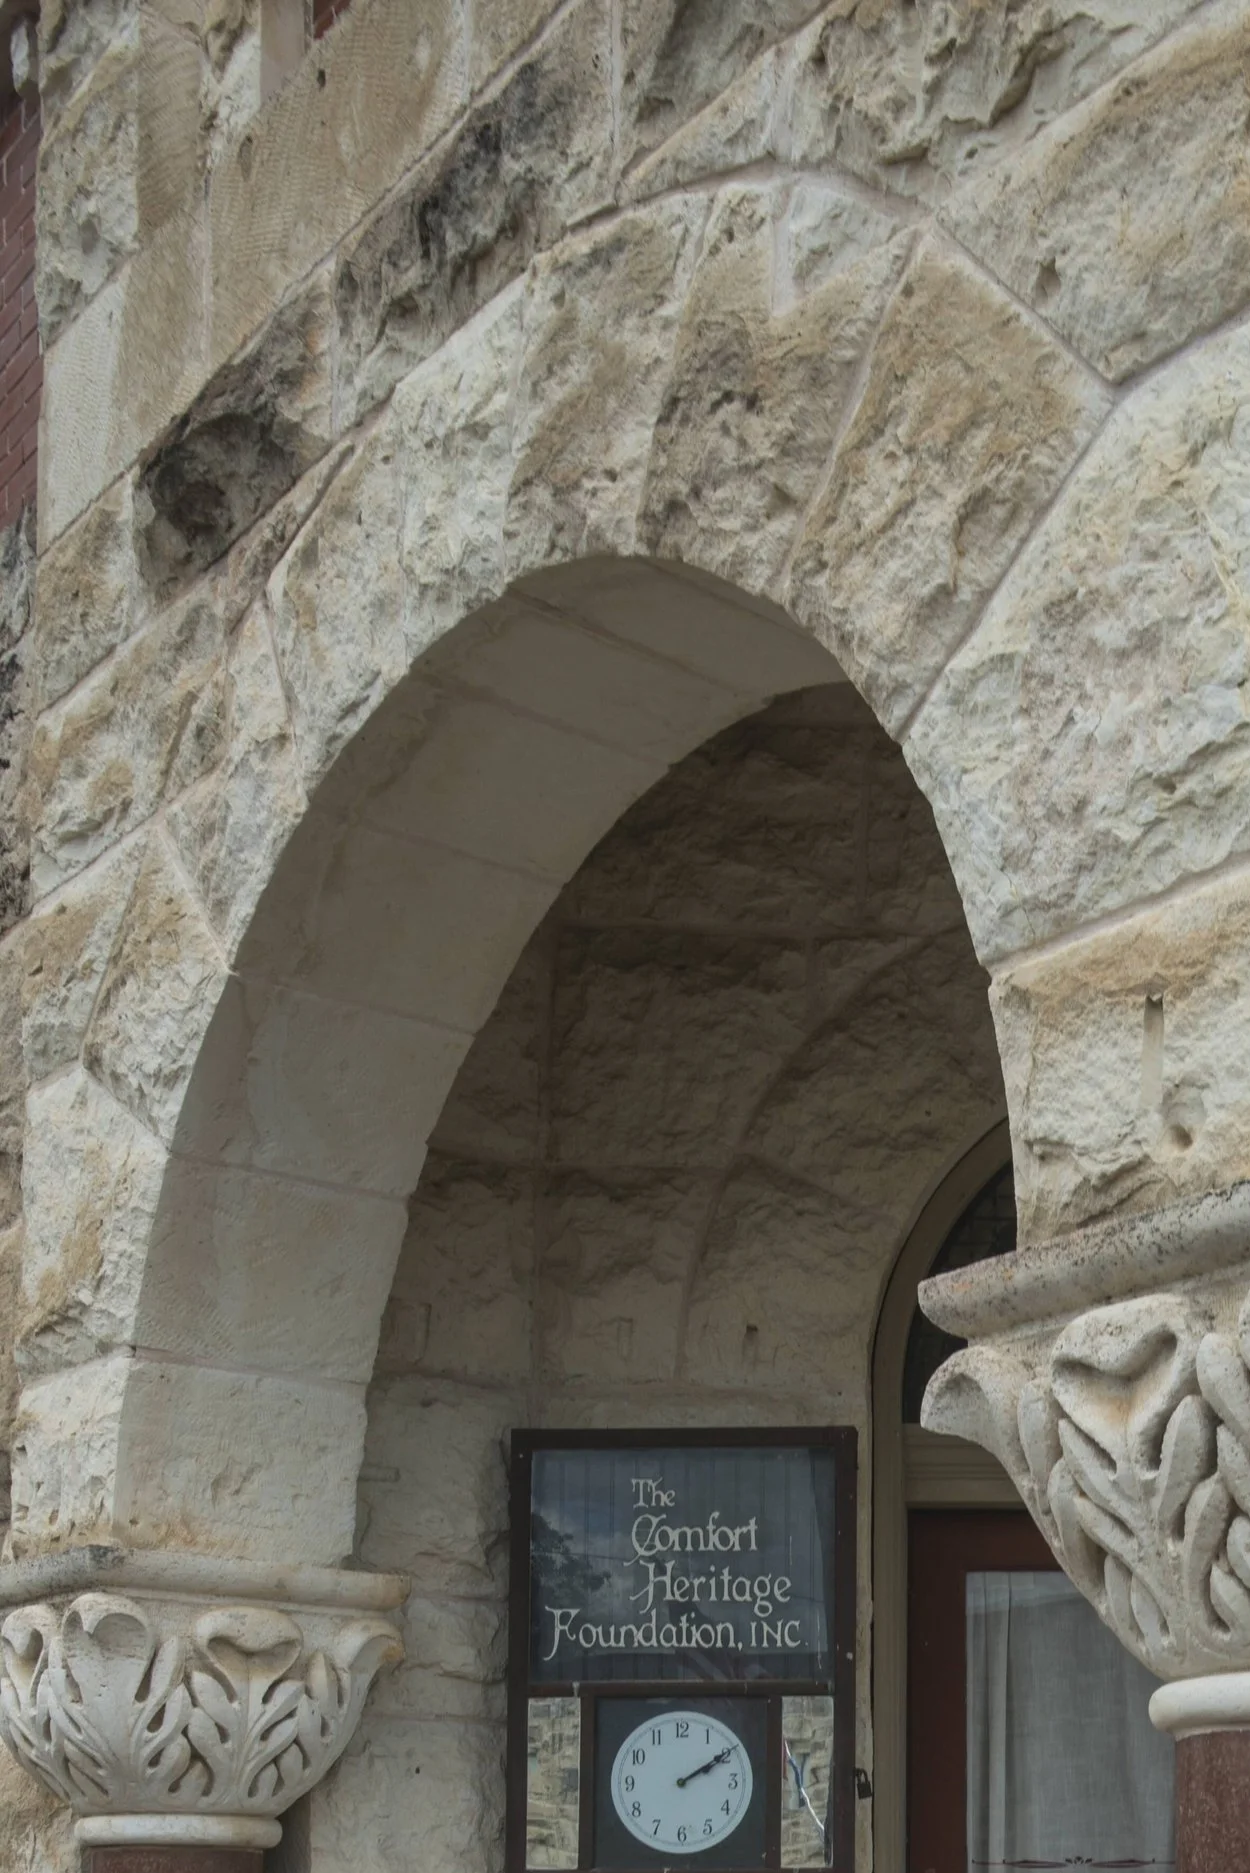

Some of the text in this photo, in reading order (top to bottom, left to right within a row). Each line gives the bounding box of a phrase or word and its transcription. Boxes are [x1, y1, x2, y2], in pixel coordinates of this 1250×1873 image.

[631, 1477, 676, 1508] The
[623, 1511, 758, 1567] Comfort
[629, 1560, 792, 1617] Heritage
[543, 1606, 744, 1661] Foundation,
[651, 1728, 662, 1745] 11
[675, 1721, 690, 1738] 12
[704, 1727, 711, 1744] 1
[631, 1749, 645, 1765] 10
[625, 1775, 635, 1791] 9
[728, 1773, 738, 1790] 3
[631, 1801, 642, 1817] 8
[721, 1799, 730, 1815] 4
[652, 1819, 662, 1836] 7
[677, 1826, 687, 1842] 6
[703, 1819, 713, 1835] 5
